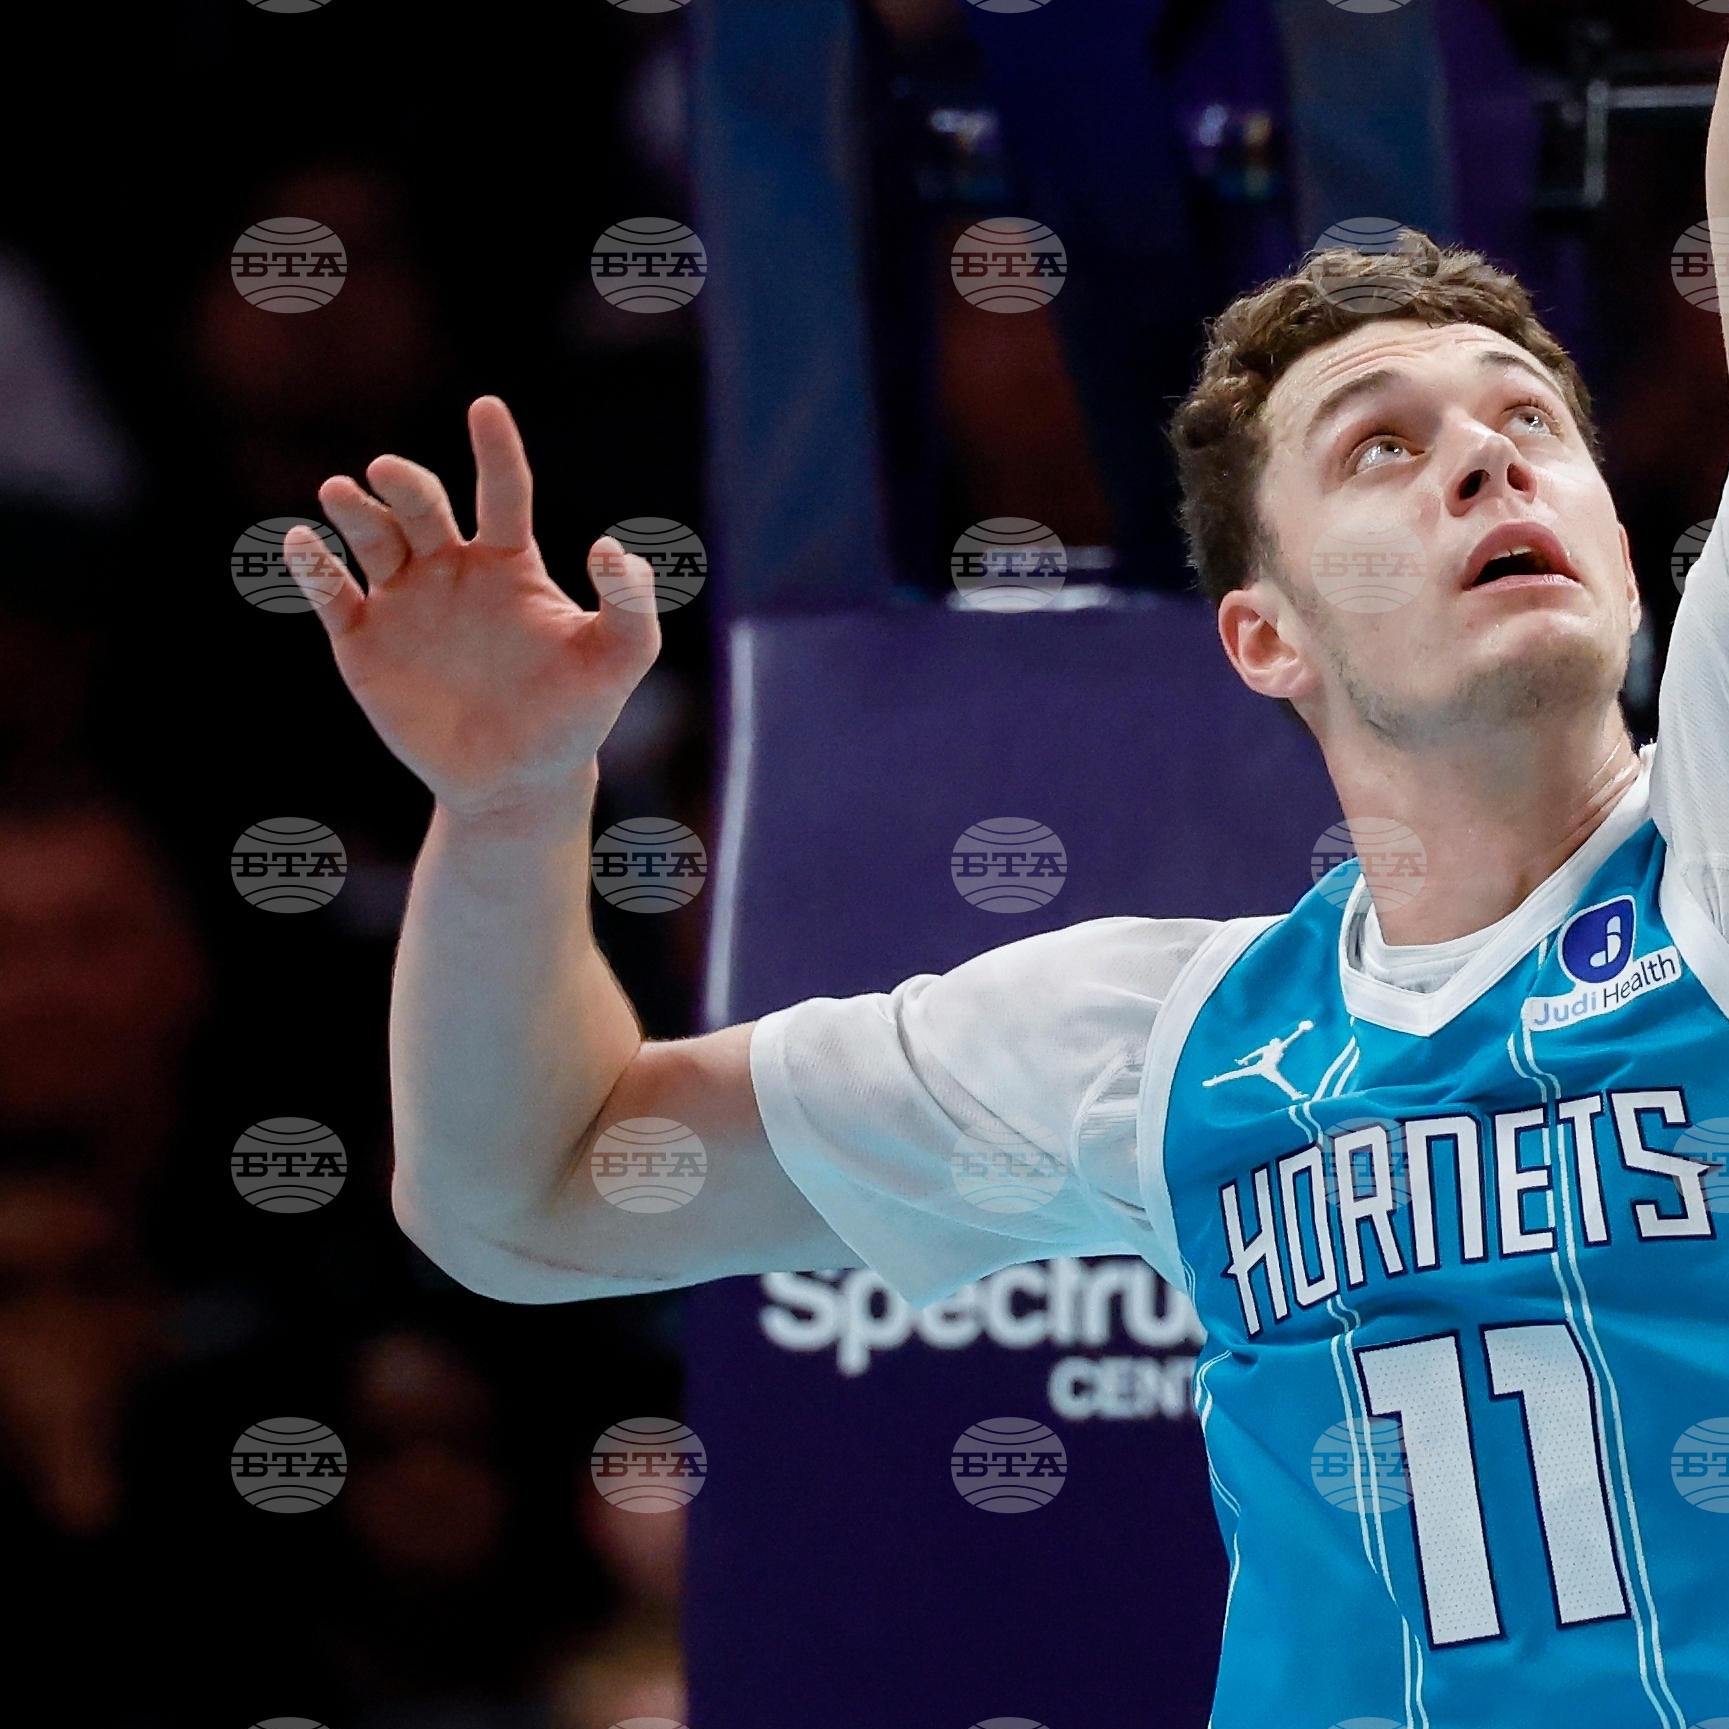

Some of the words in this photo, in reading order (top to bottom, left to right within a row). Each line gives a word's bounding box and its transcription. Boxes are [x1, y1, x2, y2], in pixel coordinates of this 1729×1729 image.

[1533, 992, 1597, 1027] Judi
[1602, 954, 1677, 1009] Health
[1221, 1086, 1716, 1339] HORNETS
[758, 1257, 1208, 1377] Spectru
[1353, 1317, 1632, 1650] 11
